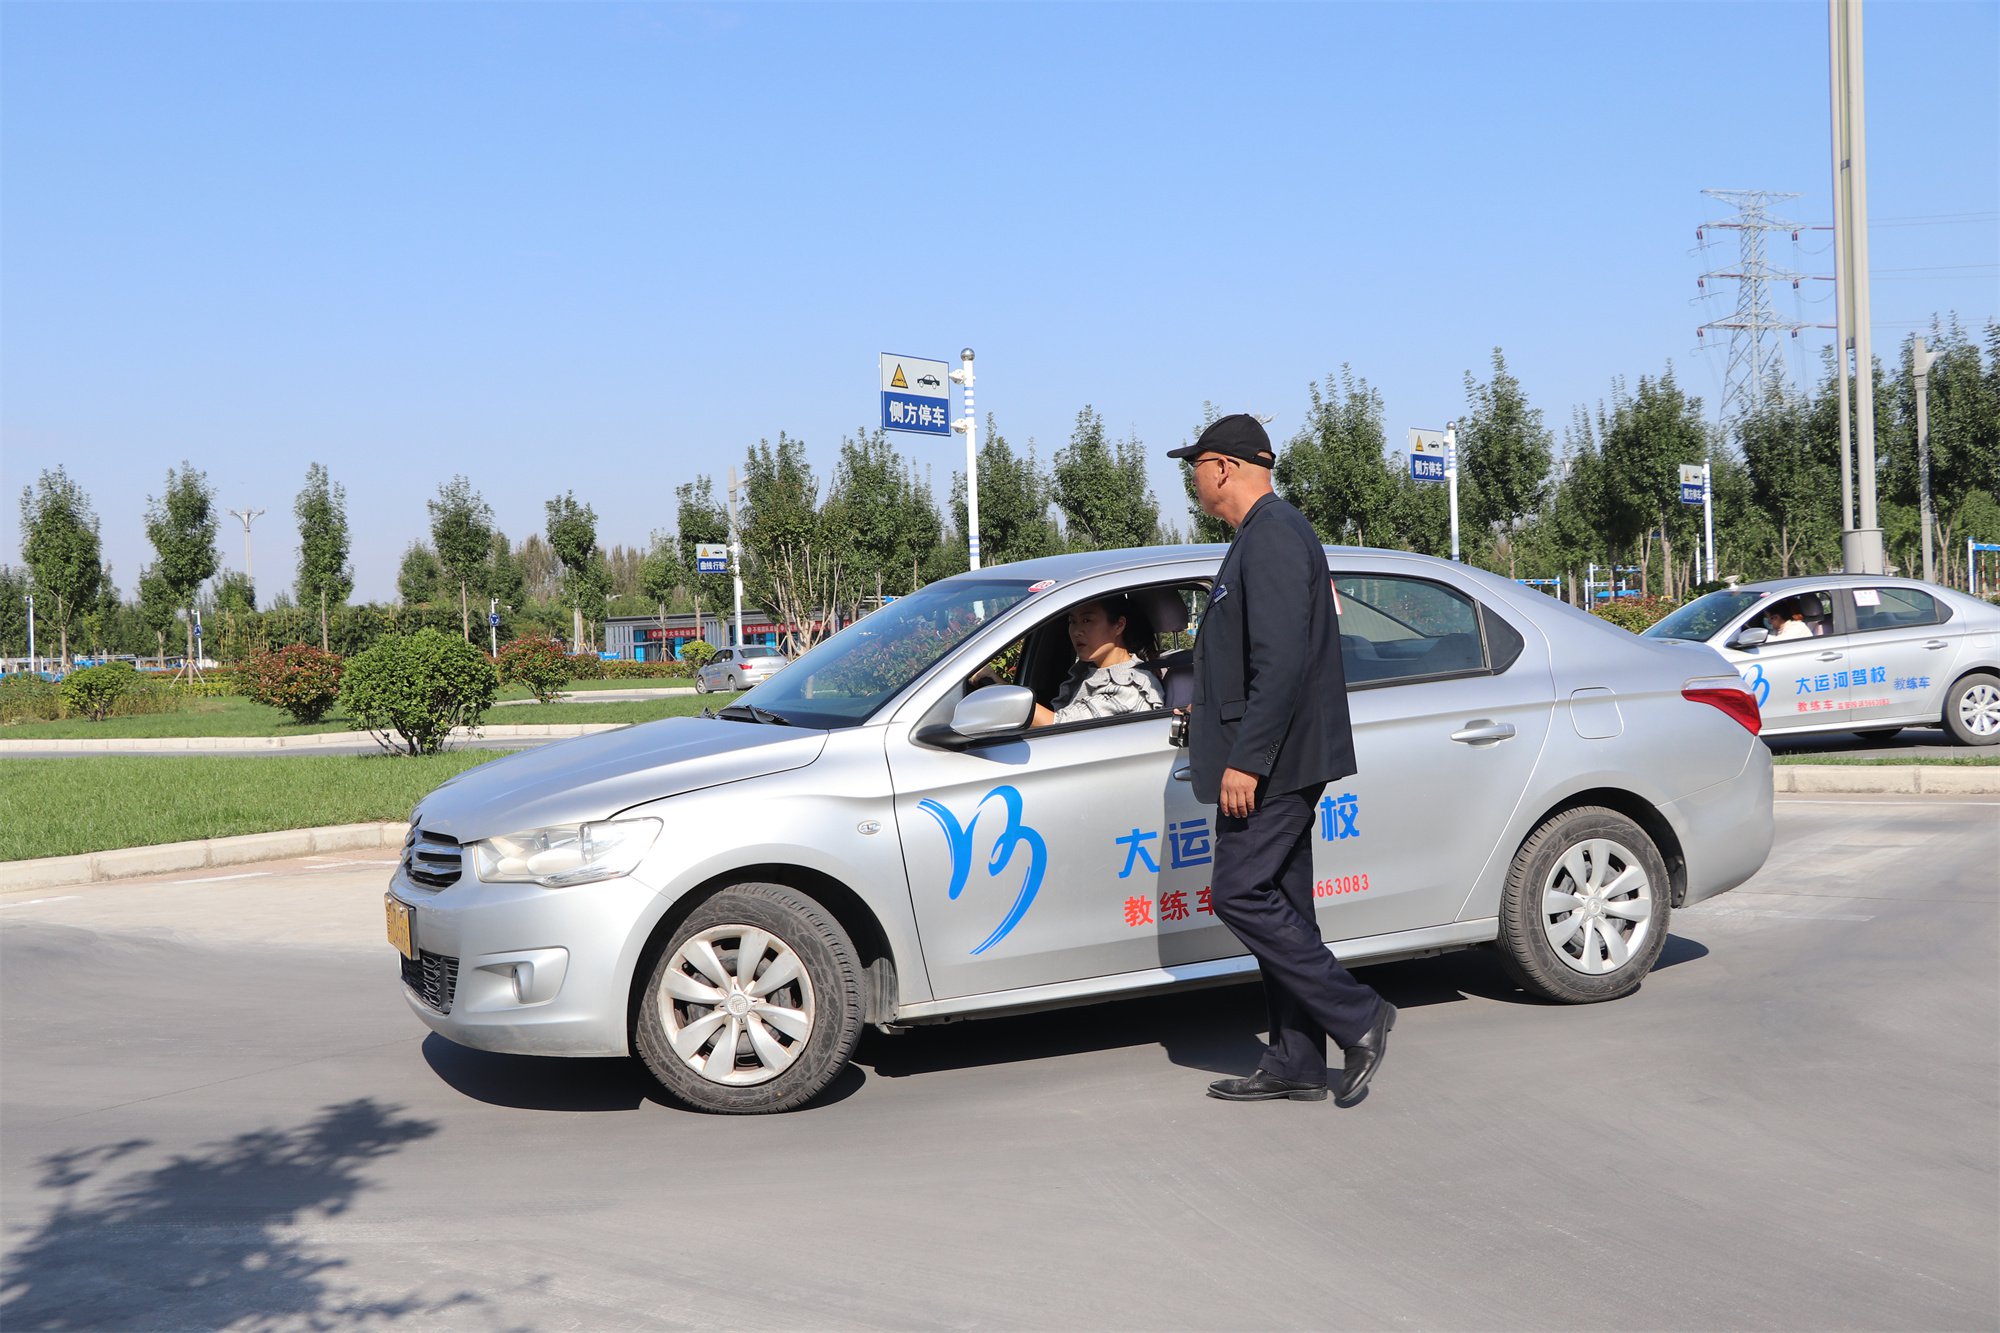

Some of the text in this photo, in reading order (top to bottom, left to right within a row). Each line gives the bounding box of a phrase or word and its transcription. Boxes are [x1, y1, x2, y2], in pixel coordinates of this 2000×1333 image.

[889, 400, 945, 427] 侧方停车
[1796, 666, 1886, 695] 大运河驾校
[1124, 886, 1214, 927] 教练车
